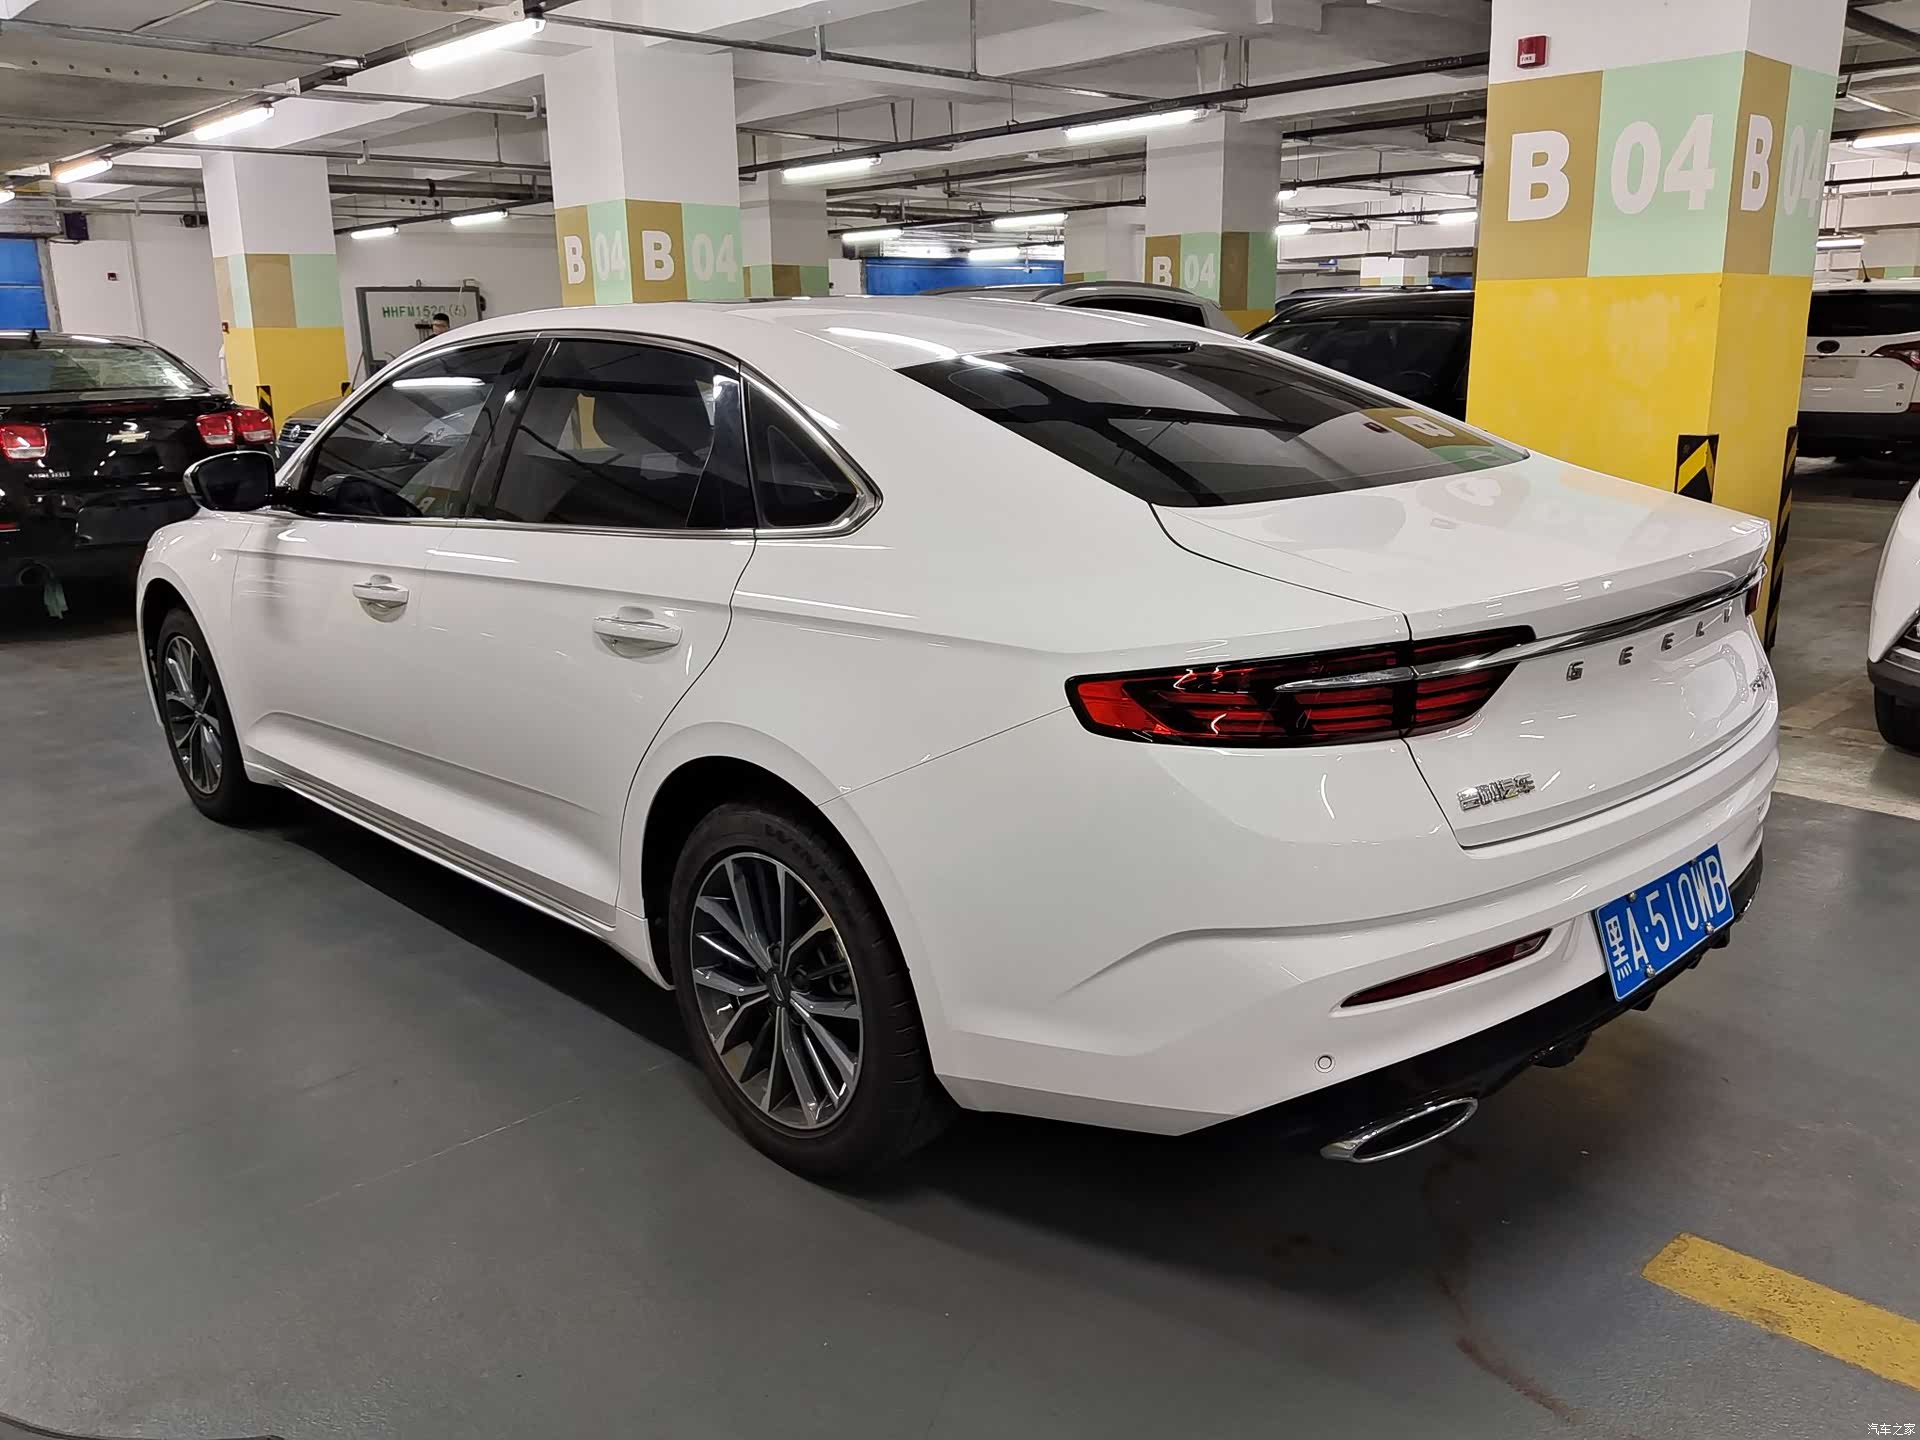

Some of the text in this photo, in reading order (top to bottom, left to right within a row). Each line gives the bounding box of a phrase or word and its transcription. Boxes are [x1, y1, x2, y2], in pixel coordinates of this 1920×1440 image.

[1507, 113, 1715, 222] B 04
[1740, 114, 1824, 217] B 04
[564, 230, 625, 284] B 04
[642, 230, 738, 282] B 04
[1152, 253, 1216, 288] B 04
